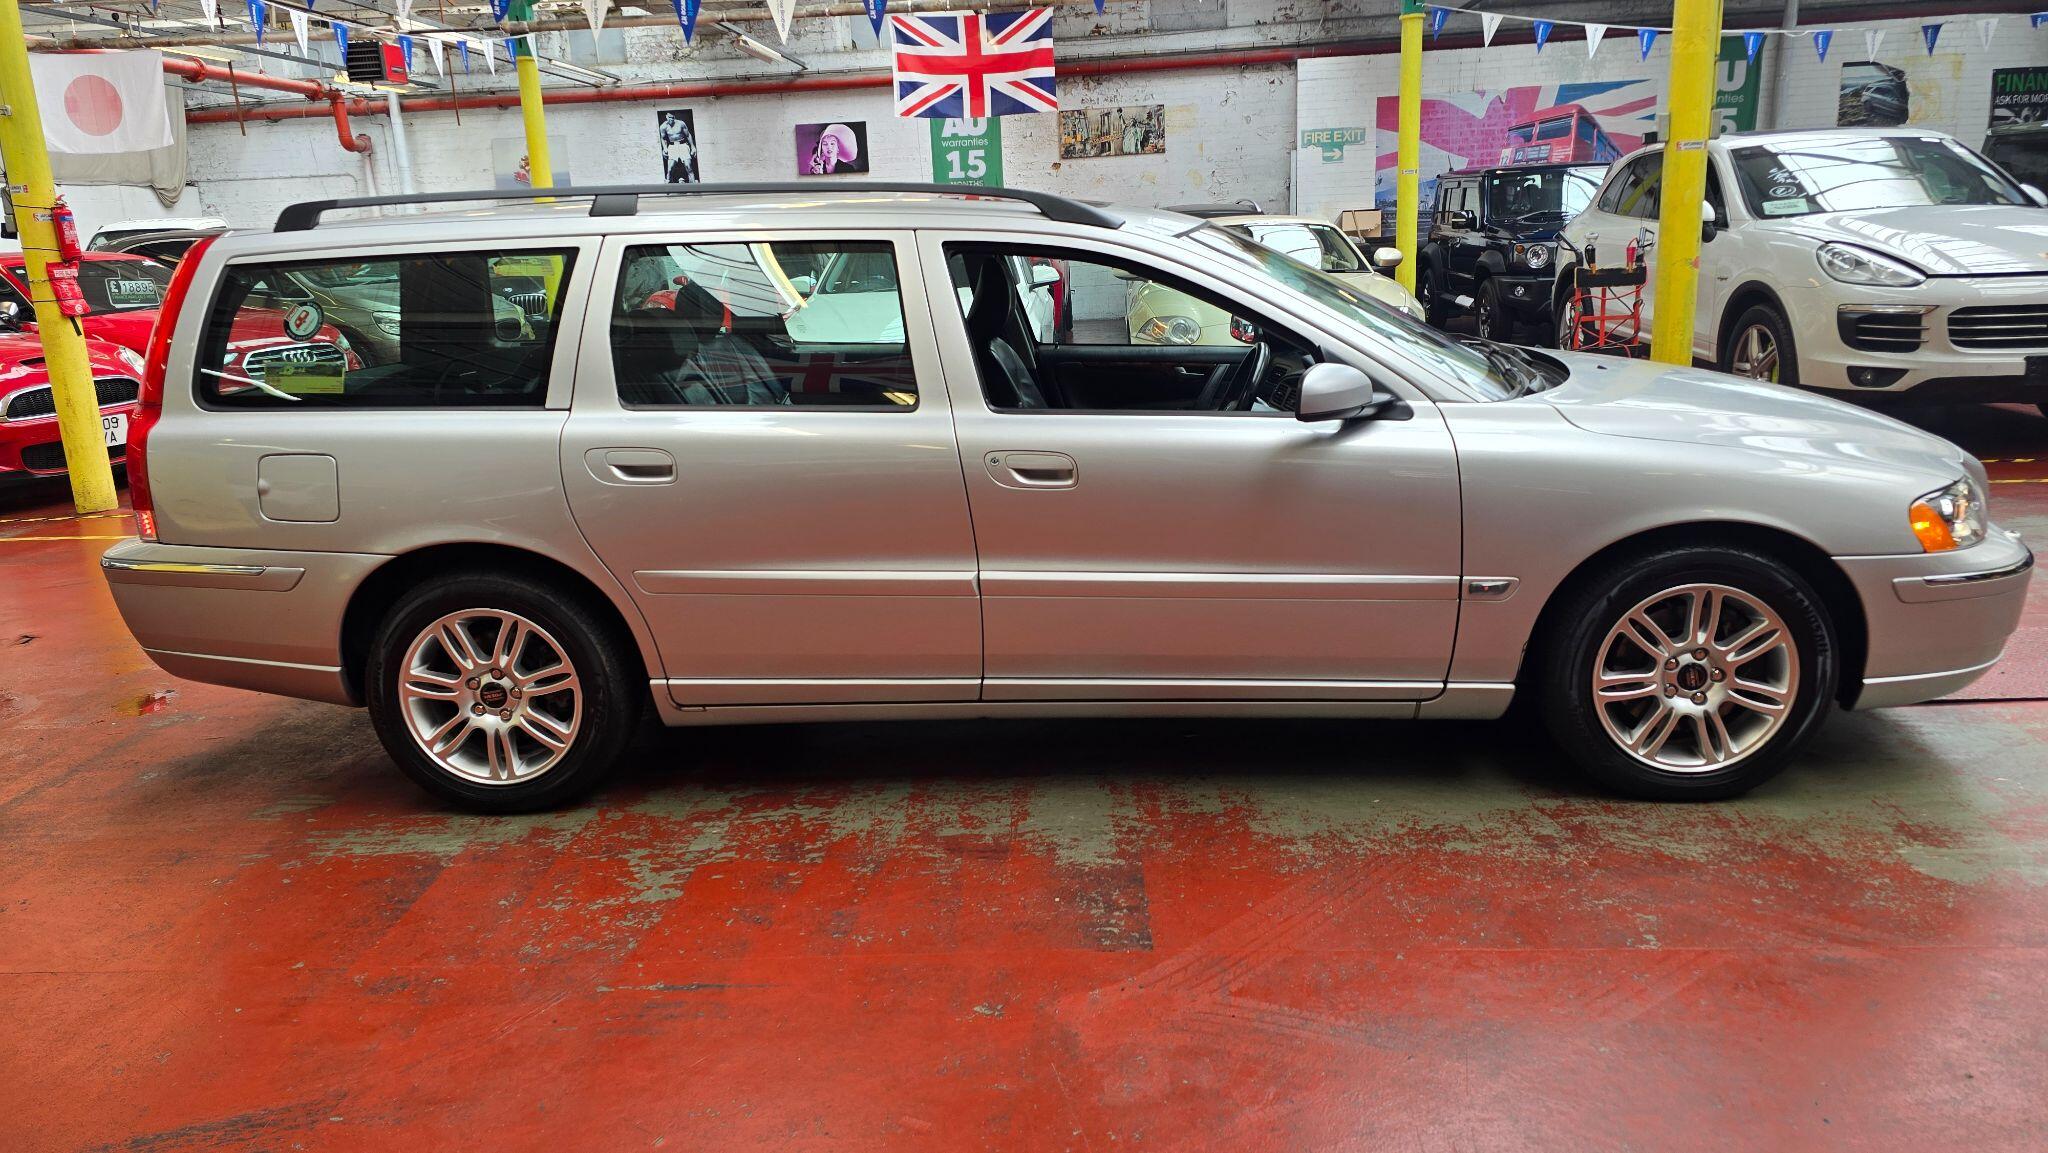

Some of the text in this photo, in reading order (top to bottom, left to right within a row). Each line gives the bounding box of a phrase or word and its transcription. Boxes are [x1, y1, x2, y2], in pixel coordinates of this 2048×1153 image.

[1716, 60, 1747, 92] U
[941, 138, 988, 147] warranties
[1304, 129, 1365, 145] FIRE EXIT
[946, 150, 987, 179] 15
[103, 416, 119, 430] 09
[105, 431, 118, 443] A
